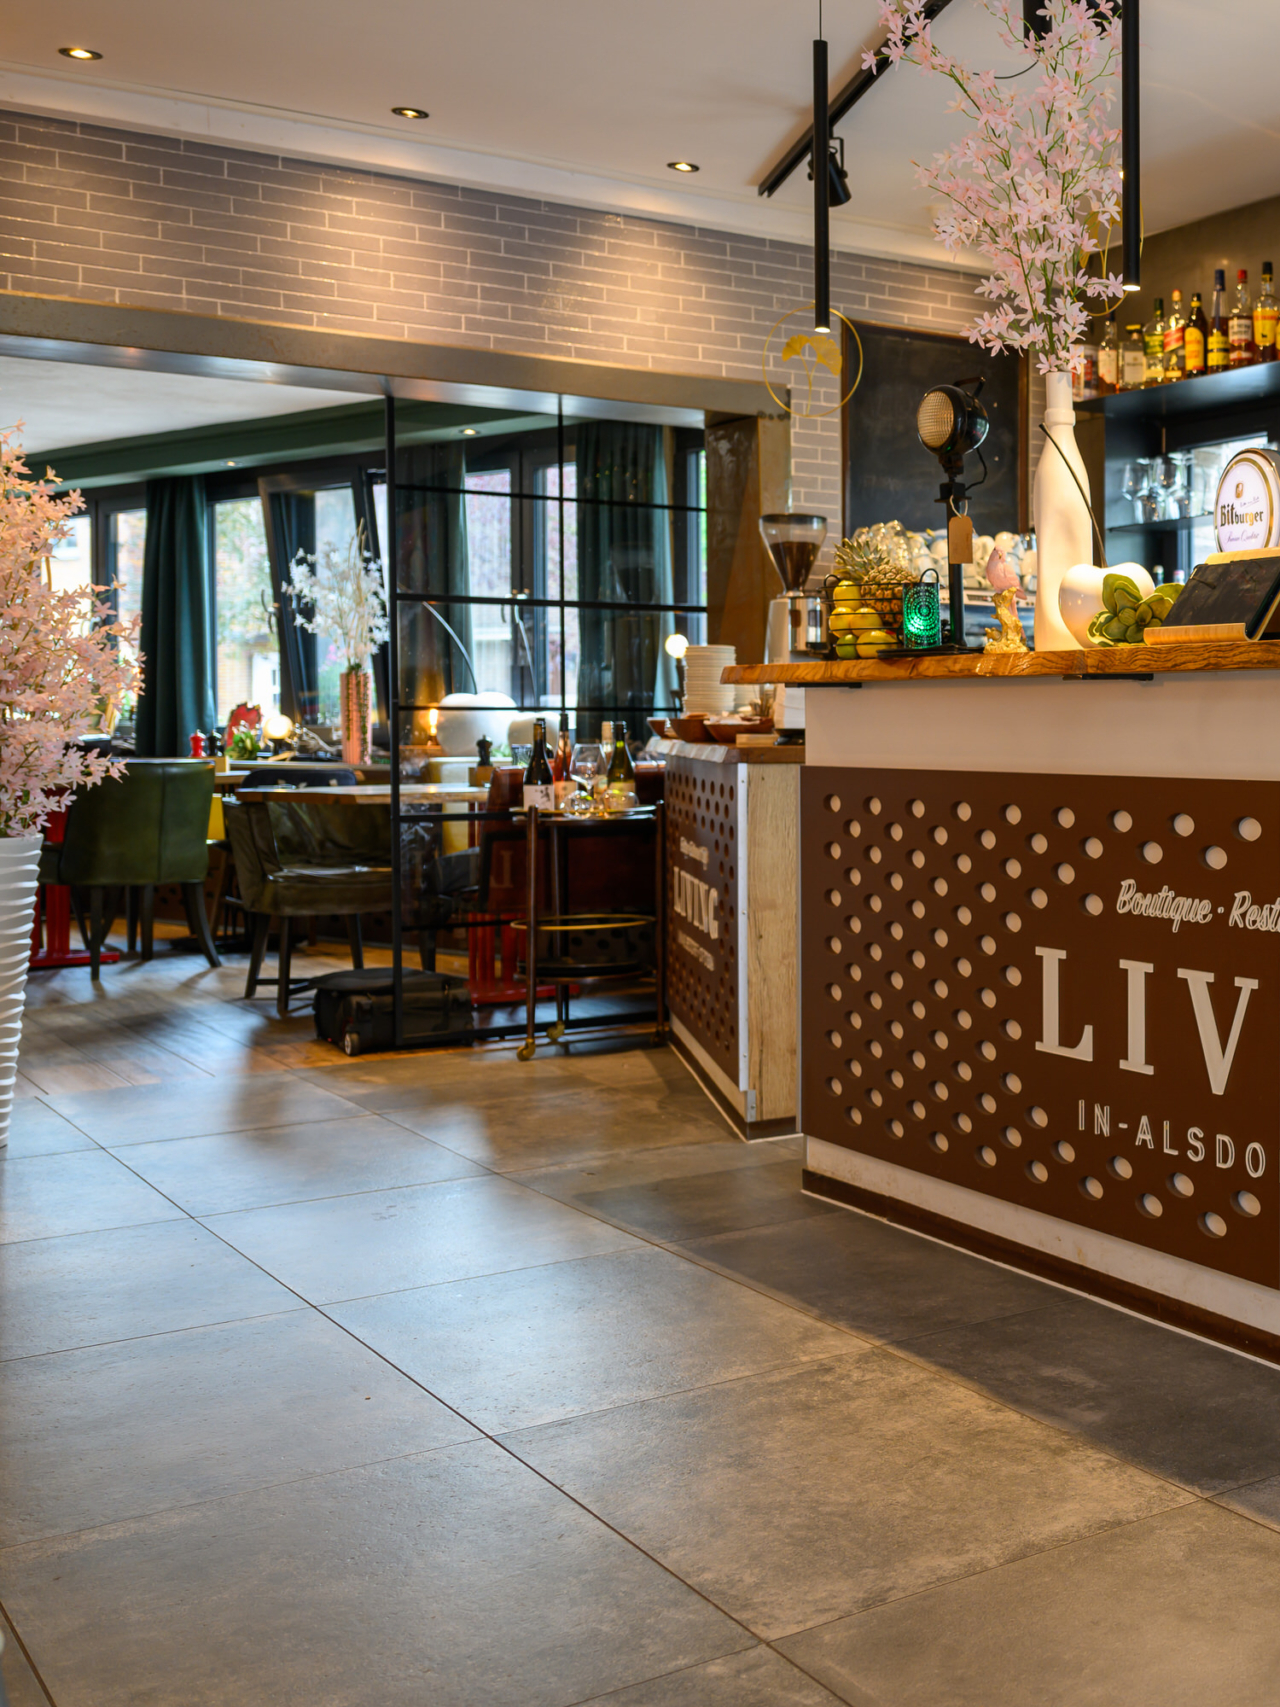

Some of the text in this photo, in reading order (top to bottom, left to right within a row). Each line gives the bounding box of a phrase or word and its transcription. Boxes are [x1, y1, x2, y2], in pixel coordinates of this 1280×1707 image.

[1220, 502, 1264, 528] Bitburger
[673, 866, 719, 940] LIVING
[1116, 878, 1213, 933] Boutique
